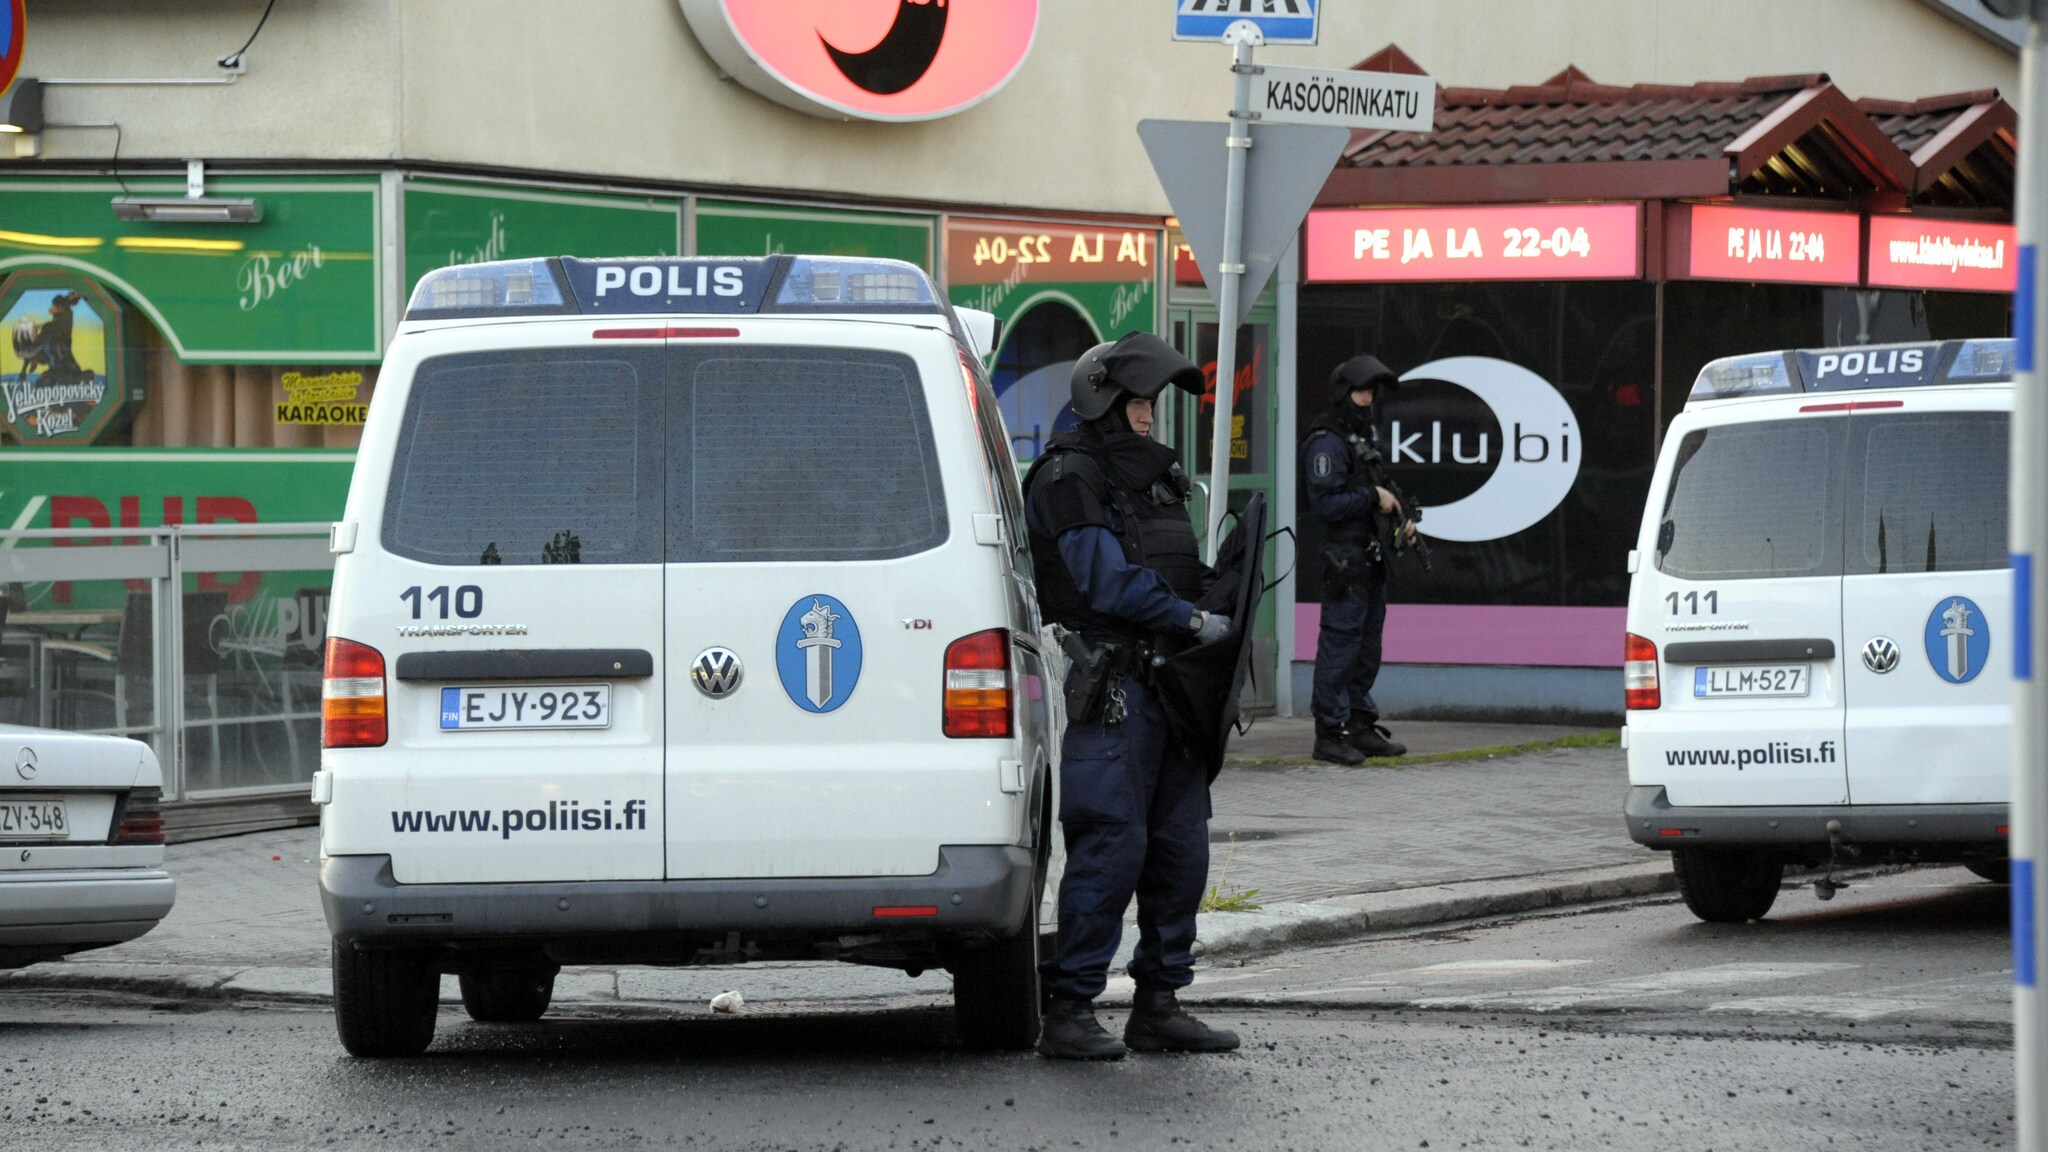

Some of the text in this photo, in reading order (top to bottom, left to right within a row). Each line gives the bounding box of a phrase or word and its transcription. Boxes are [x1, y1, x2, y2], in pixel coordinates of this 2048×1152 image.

[1267, 76, 1419, 119] KASÖÖRINKATU
[1354, 227, 1590, 264] PE JA LA 22-04
[1728, 227, 1744, 258] PE
[1766, 229, 1782, 259] LA
[1789, 231, 1824, 262] 22-04
[236, 243, 325, 312] Beer
[595, 265, 743, 297] POLIS
[1817, 349, 1924, 379] POLIS
[36, 407, 79, 437] Kozel
[277, 405, 367, 422] KARAOKE
[1391, 420, 1570, 464] klubi
[400, 585, 483, 620] 110
[1665, 590, 1717, 616] 111
[397, 624, 528, 637] TRANSPORTER
[901, 618, 932, 630] TDI
[442, 711, 459, 722] FIN
[1666, 741, 1836, 771] www.poliisi.fi
[391, 799, 646, 840] www.poliisi.fi
